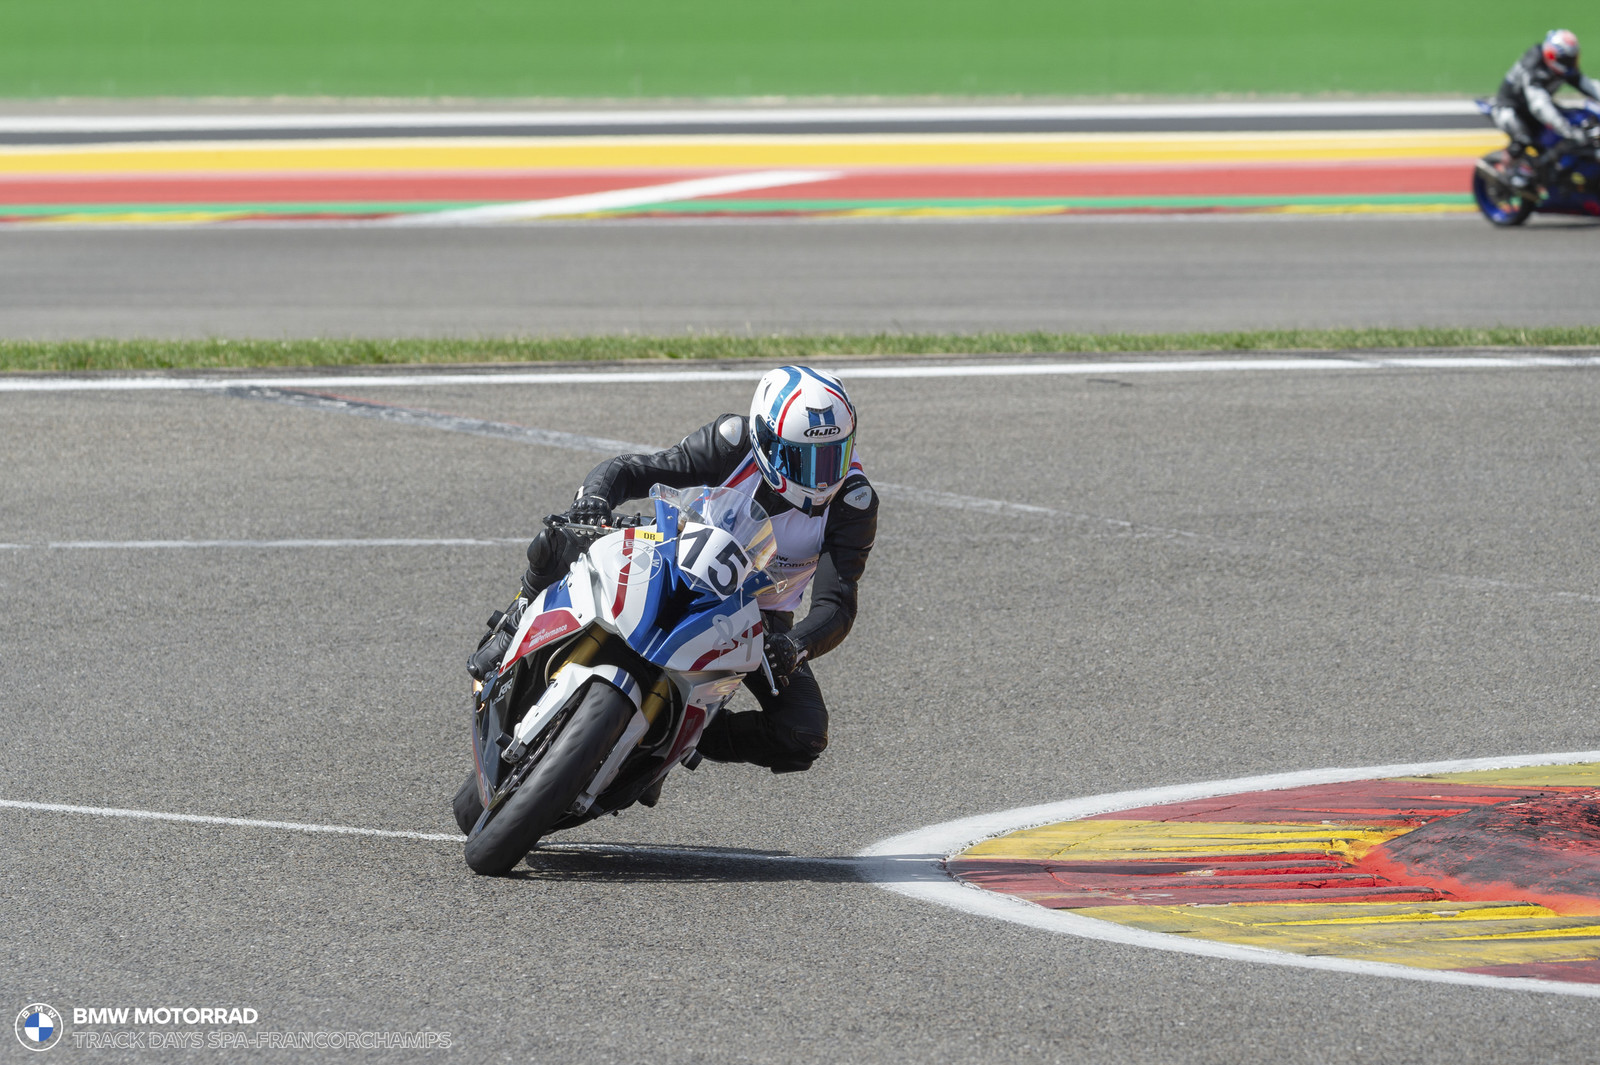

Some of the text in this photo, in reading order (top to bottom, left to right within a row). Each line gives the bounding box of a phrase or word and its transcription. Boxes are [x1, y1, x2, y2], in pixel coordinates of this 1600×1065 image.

[809, 427, 837, 437] HJC
[643, 532, 656, 541] DB
[680, 527, 749, 597] 15
